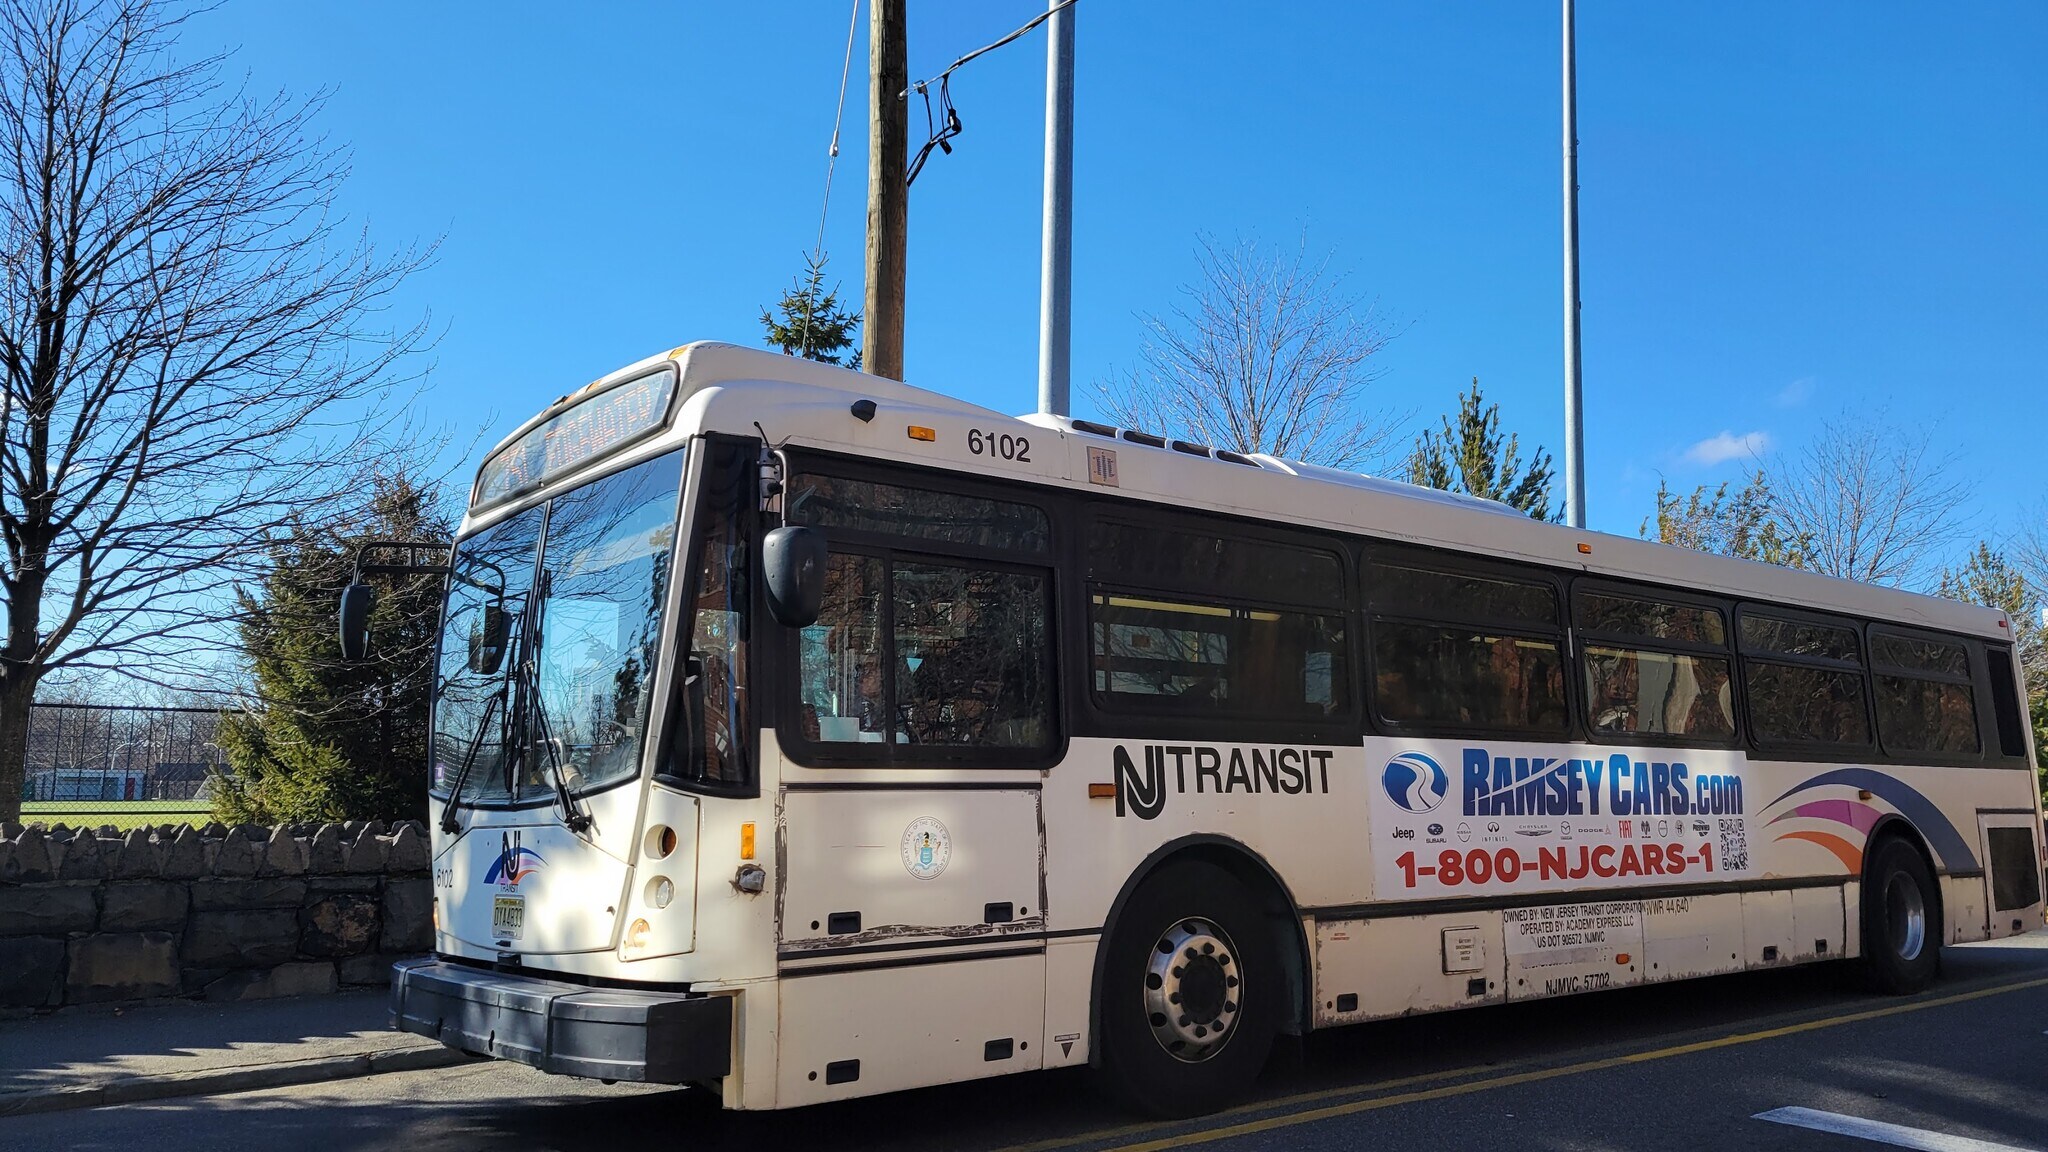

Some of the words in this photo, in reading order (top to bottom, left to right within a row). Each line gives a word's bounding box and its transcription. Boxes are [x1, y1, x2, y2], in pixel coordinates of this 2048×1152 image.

[967, 428, 1031, 463] 6102
[1113, 744, 1166, 820] NJ
[1165, 745, 1334, 795] TRANSIT
[1392, 826, 1415, 841] Jeep
[1618, 820, 1633, 839] FIAT
[1396, 843, 1714, 888] 1-800-NJCARS-1
[437, 868, 454, 888] 6102
[1504, 910, 1528, 923] OWNED
[1529, 909, 1540, 920] BY:
[1541, 907, 1555, 919] NEW
[1556, 906, 1579, 918] JERSEY
[1580, 904, 1605, 916] TRANSIT
[1605, 901, 1646, 914] CORPORATION
[1665, 896, 1689, 914] 44,640
[1520, 922, 1554, 935] OPERATED
[1555, 921, 1565, 931] BY:
[1566, 917, 1595, 930] ACADEMY
[1596, 916, 1623, 928] EXPRESS
[1623, 915, 1634, 926] LLC
[1537, 936, 1546, 948] US
[1547, 935, 1561, 947] DOT
[1584, 931, 1606, 943] NJMVC
[1545, 976, 1579, 995] NJMVC
[1583, 972, 1610, 990] 57702
